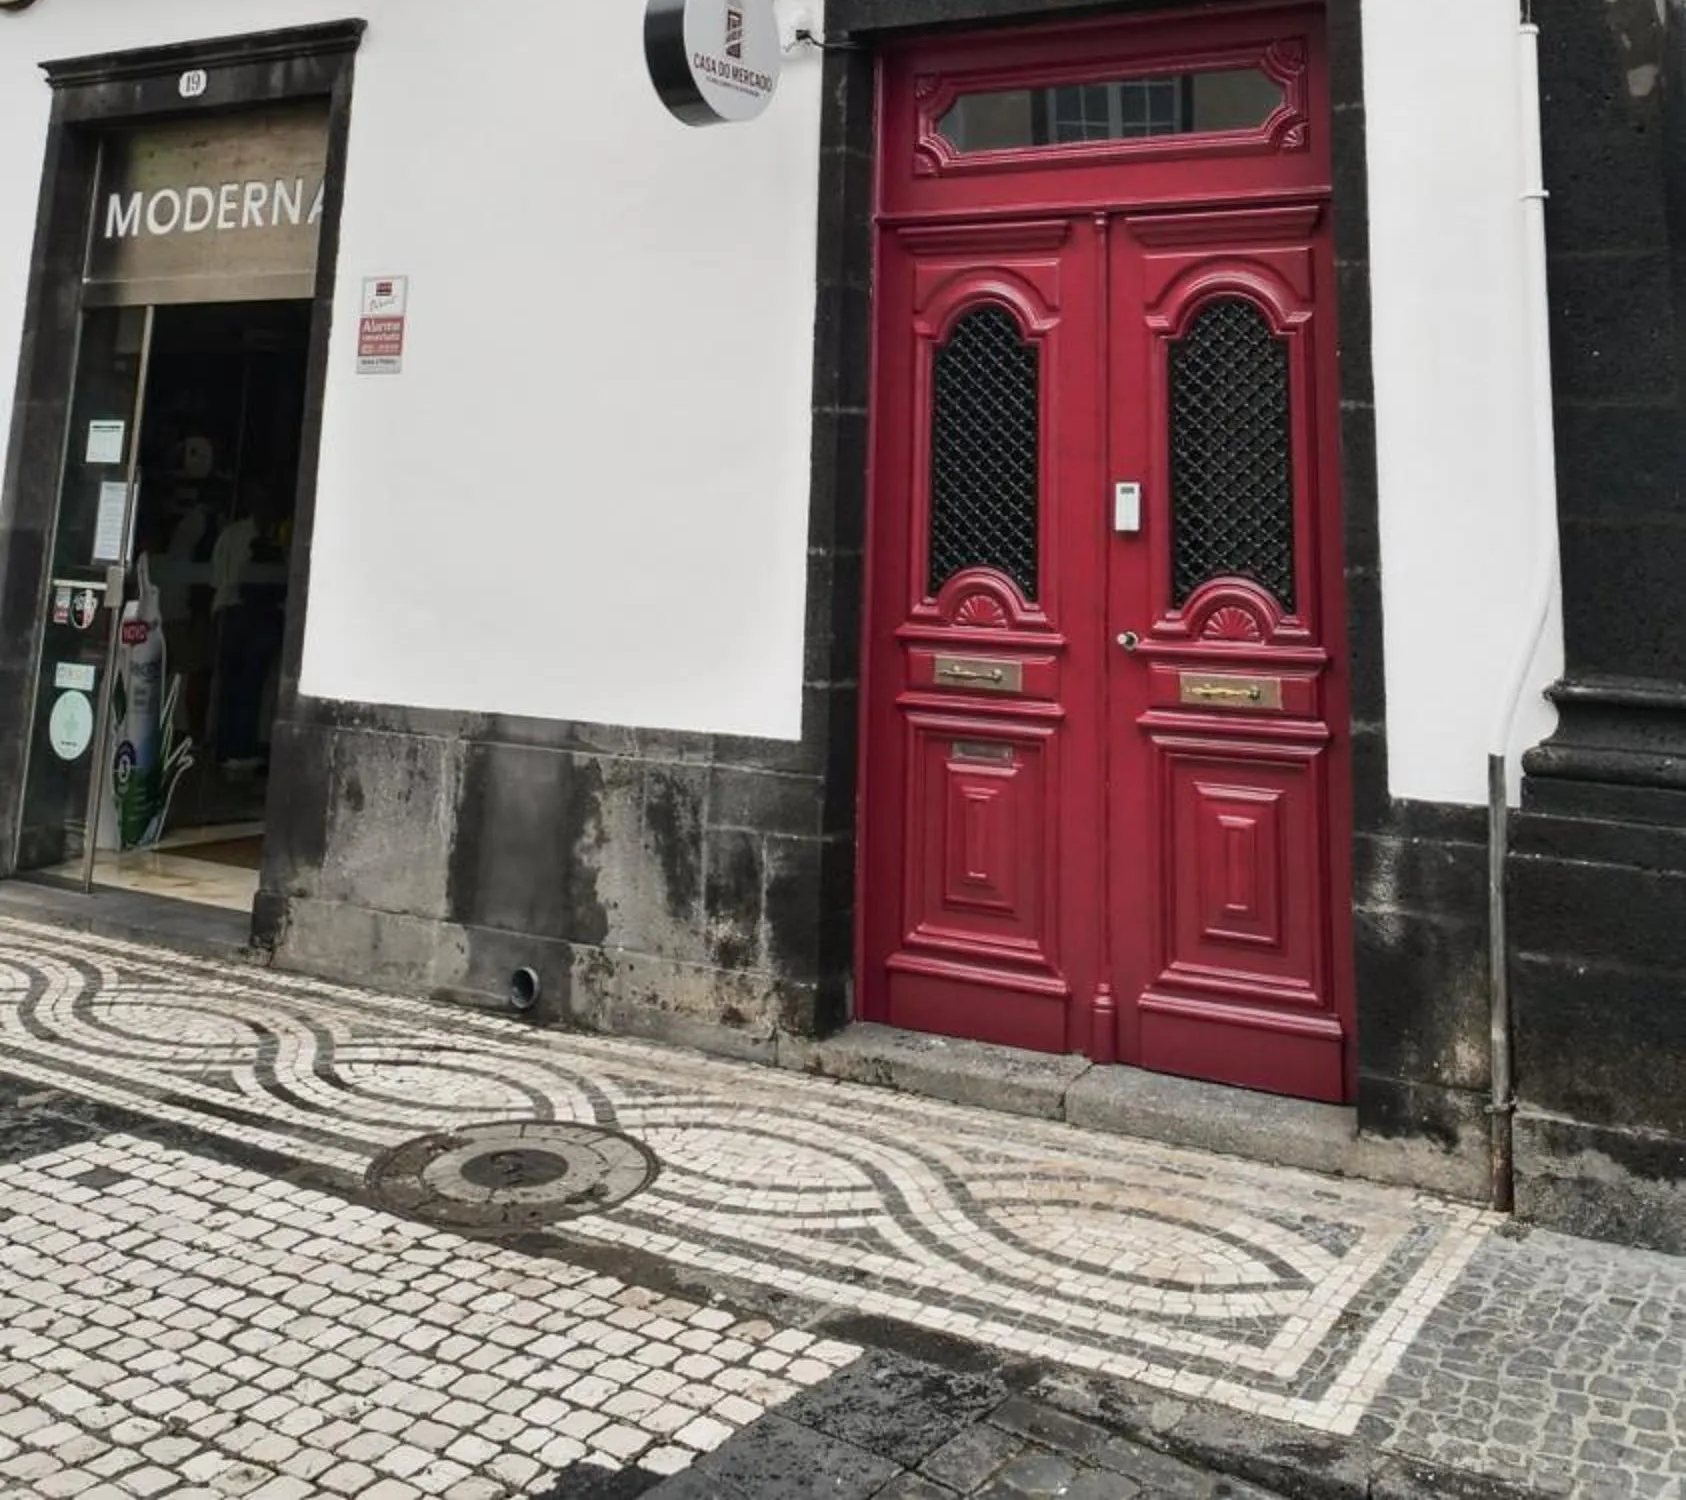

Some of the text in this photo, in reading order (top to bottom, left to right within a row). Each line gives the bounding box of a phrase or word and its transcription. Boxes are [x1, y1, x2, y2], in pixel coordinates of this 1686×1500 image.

[184, 73, 202, 92] 19
[694, 53, 717, 75] CASA
[718, 61, 730, 79] DO
[731, 64, 773, 92] MERCADO
